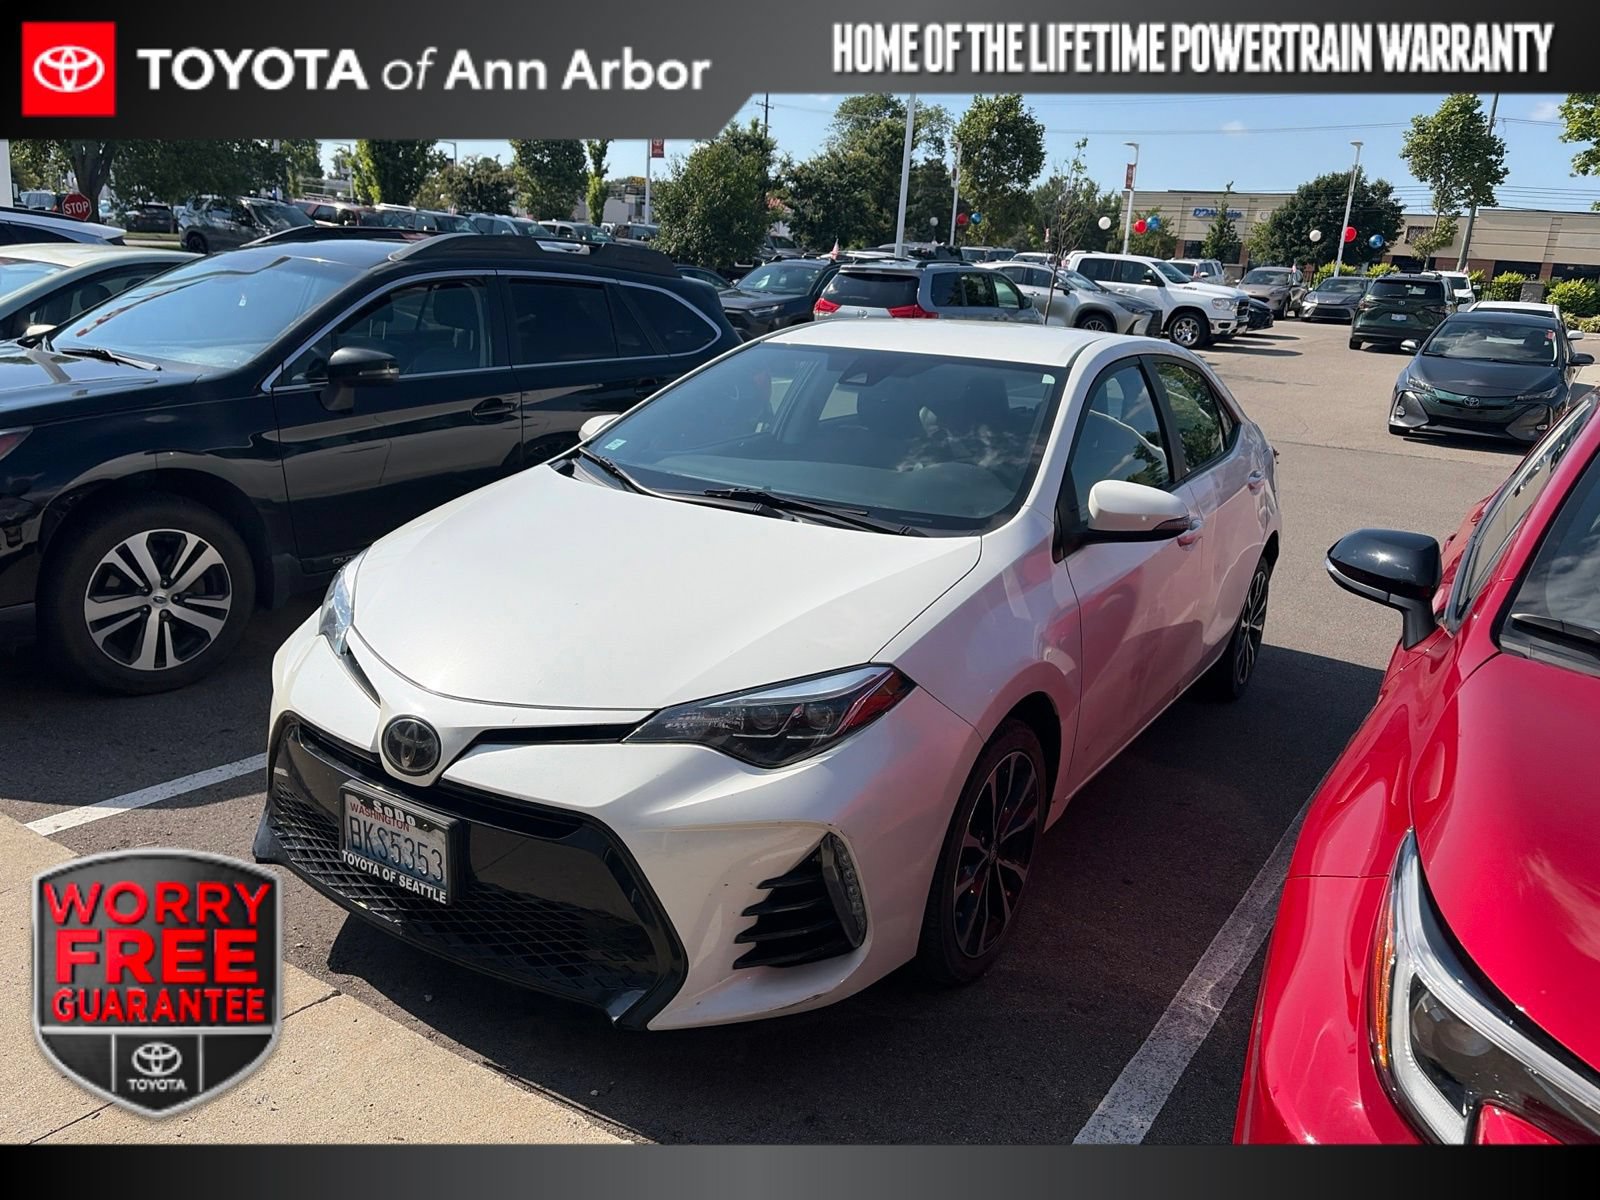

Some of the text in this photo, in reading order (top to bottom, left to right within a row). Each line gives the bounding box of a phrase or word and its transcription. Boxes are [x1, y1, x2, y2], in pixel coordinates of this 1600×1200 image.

[64, 201, 89, 215] STOP
[350, 802, 410, 832] WASHINGTON
[349, 815, 444, 883] BKS5353
[341, 849, 447, 905] TOYOTA OF SEATTLE
